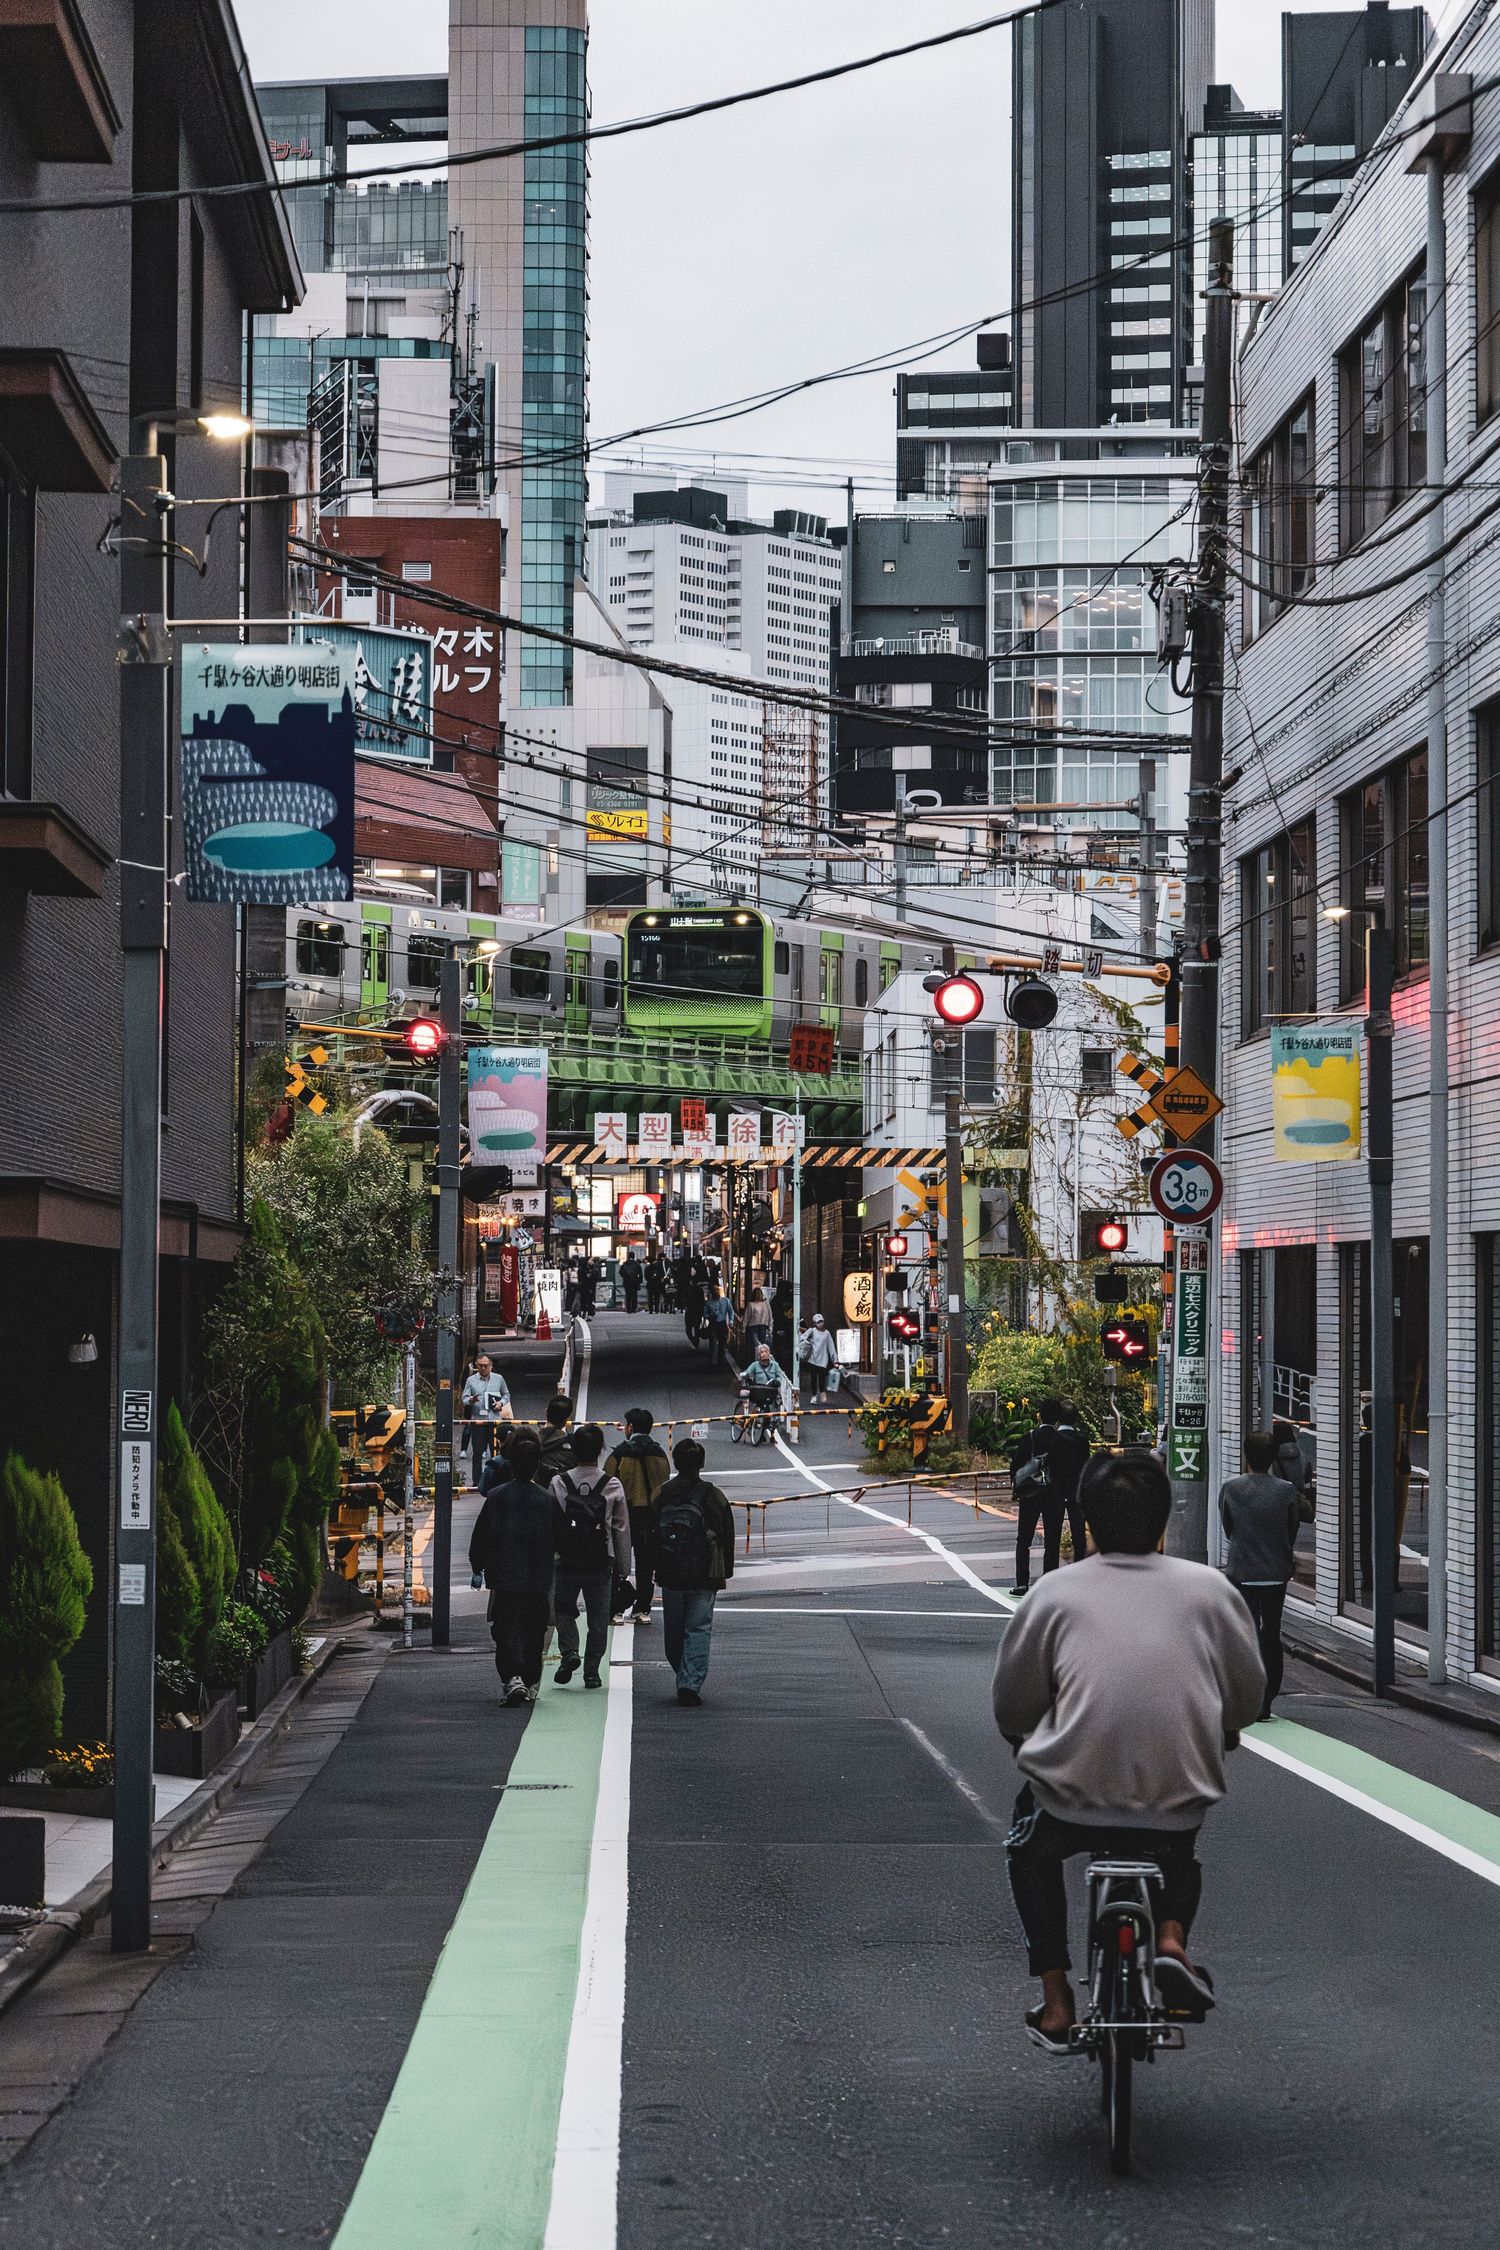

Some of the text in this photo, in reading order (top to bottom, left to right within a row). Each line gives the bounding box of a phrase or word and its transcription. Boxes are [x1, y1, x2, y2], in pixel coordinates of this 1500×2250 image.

[776, 927, 784, 937] JR
[1165, 1170, 1209, 1203] 3.8m
[854, 1276, 871, 1317] 酒と飯
[124, 1391, 150, 1430] NERO
[131, 1445, 140, 1519] 防犯カメラ作動中
